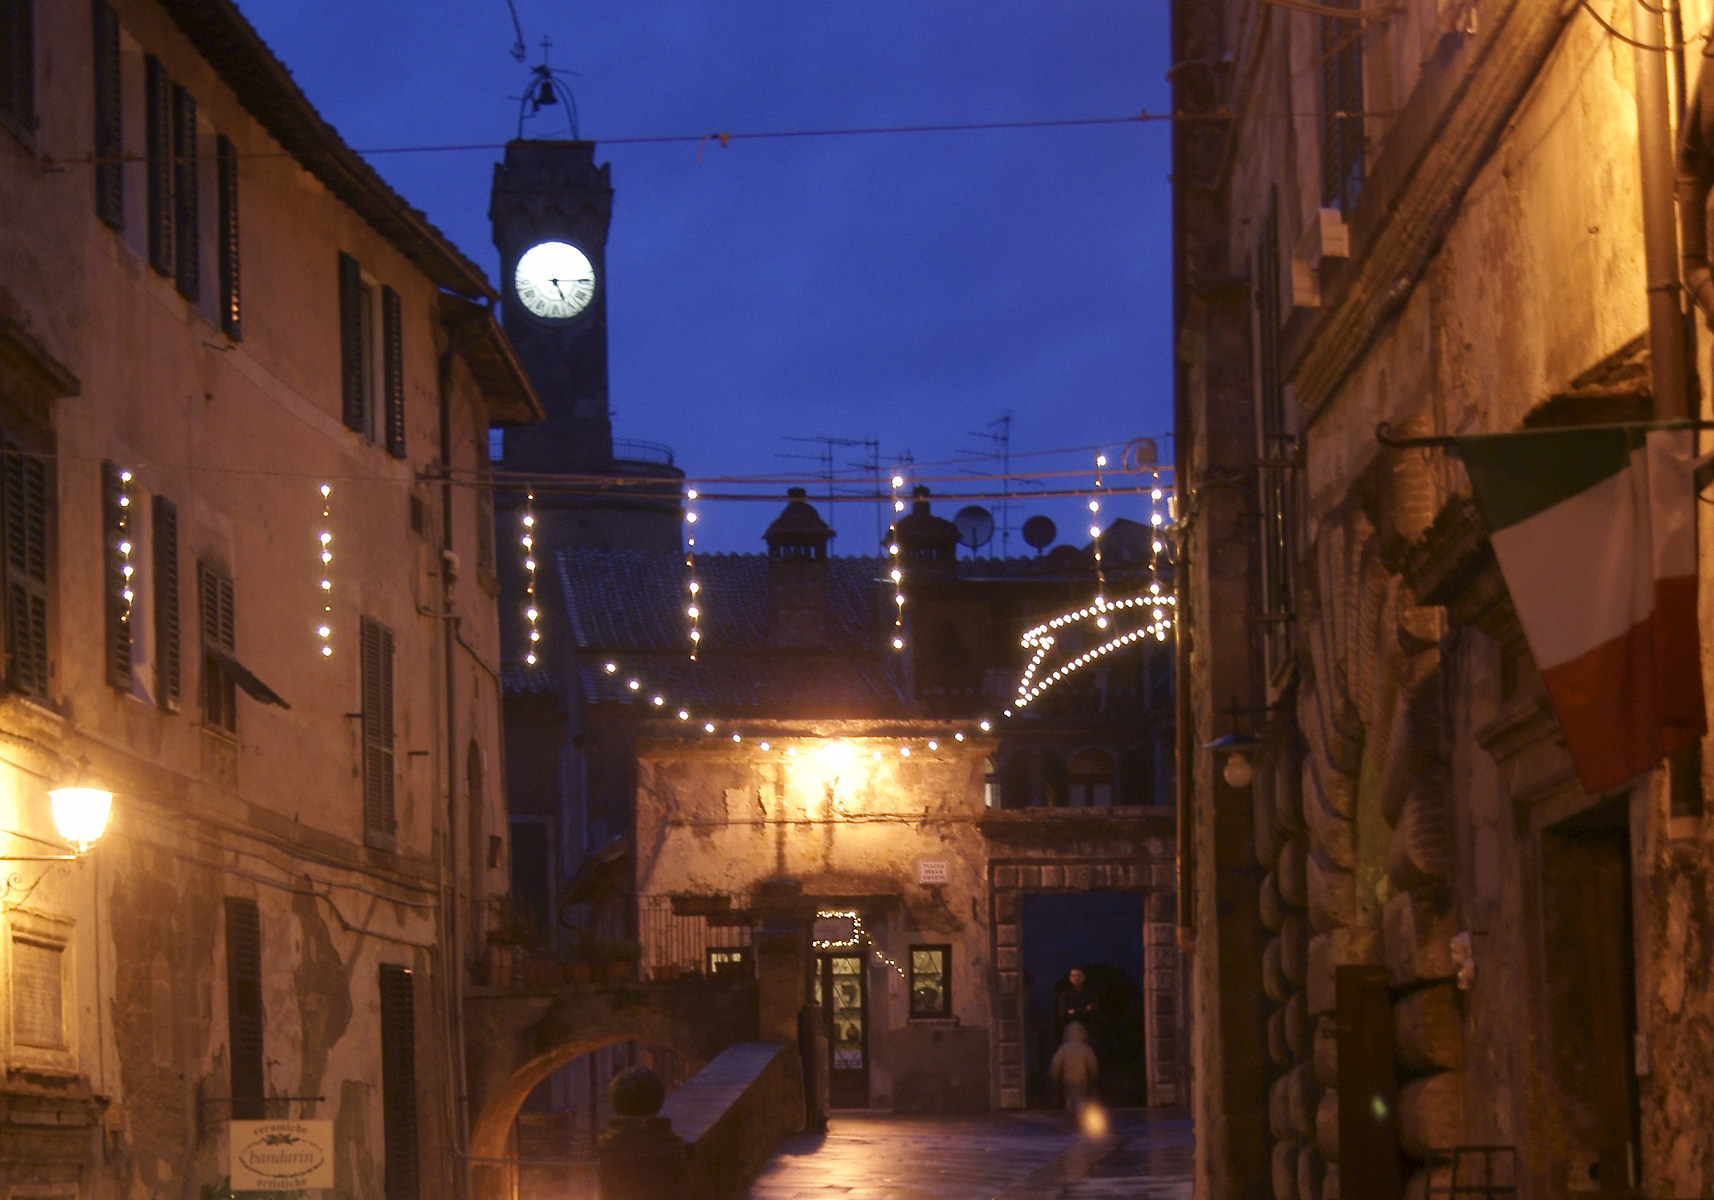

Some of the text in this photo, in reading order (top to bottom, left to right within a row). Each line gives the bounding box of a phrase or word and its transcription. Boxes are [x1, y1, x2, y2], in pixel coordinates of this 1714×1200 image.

[254, 1122, 308, 1134] ceramiche
[250, 1150, 313, 1164] bandarin
[257, 1178, 306, 1187] artistiche
